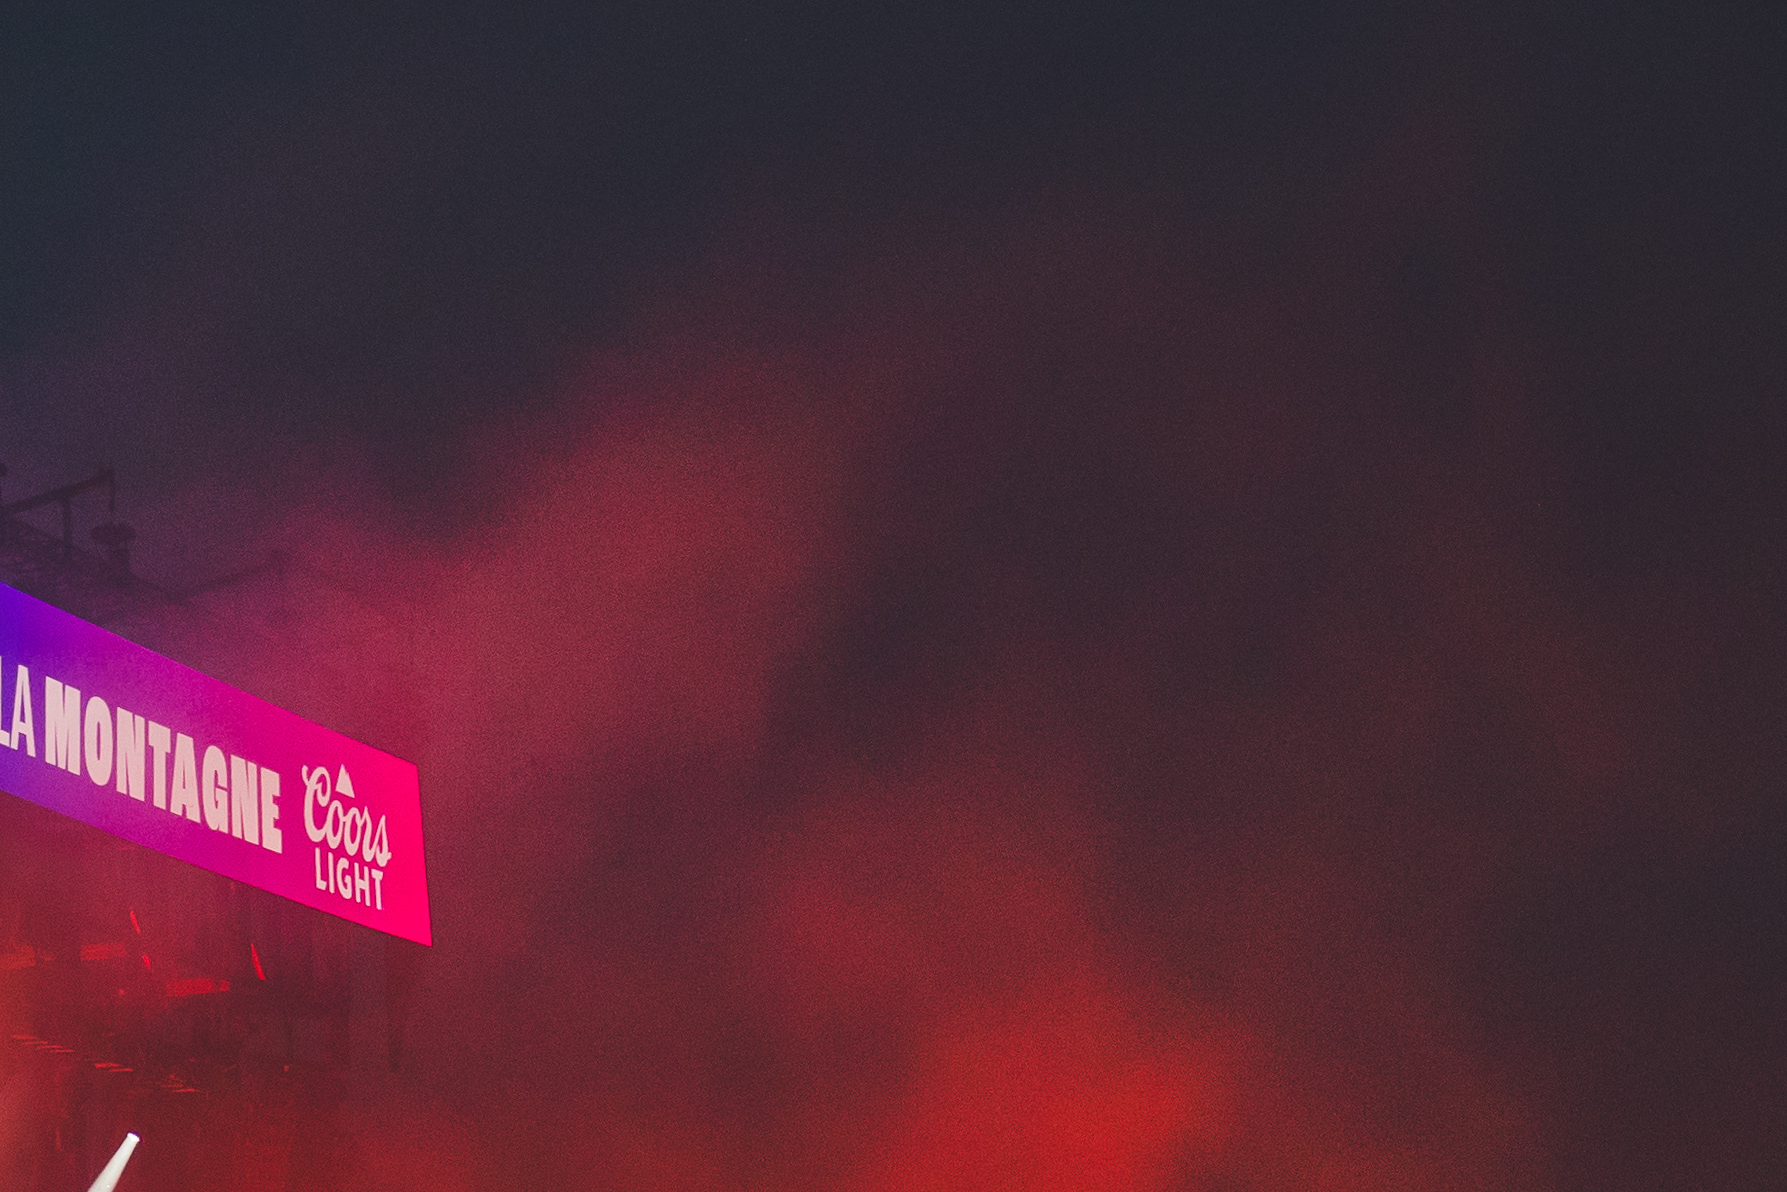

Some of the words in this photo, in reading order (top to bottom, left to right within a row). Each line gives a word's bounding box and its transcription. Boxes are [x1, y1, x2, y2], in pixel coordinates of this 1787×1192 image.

[44, 676, 283, 854] MONTAGNE
[301, 764, 393, 868] Coors
[315, 847, 385, 911] LIGHT
